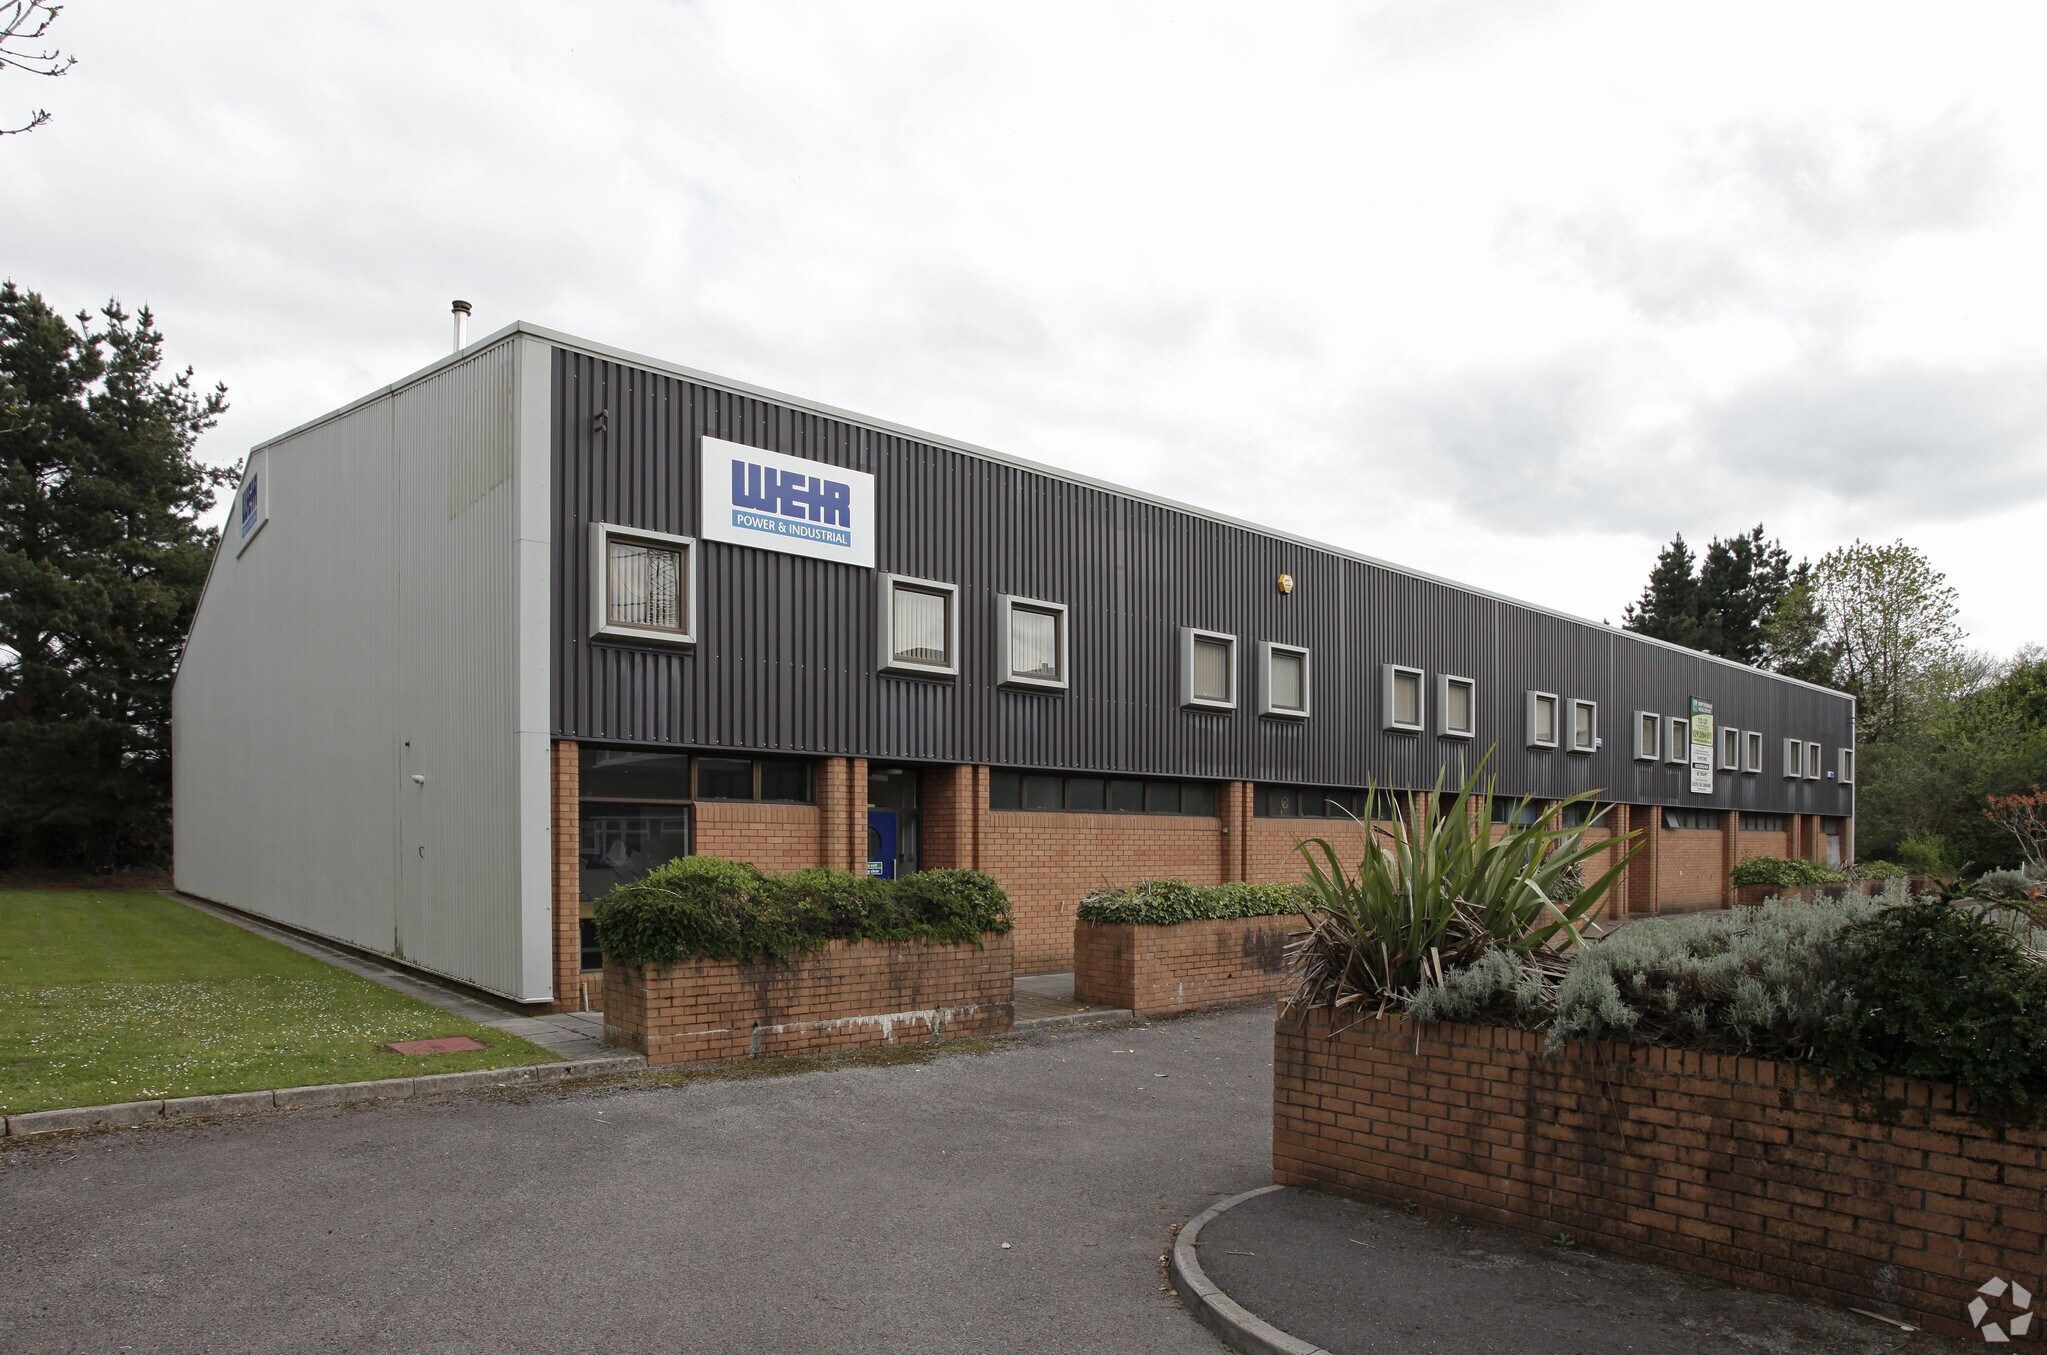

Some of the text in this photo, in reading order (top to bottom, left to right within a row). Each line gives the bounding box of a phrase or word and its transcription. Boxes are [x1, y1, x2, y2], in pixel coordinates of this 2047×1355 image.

[732, 459, 850, 528] WEIR
[737, 514, 847, 544] POWER & INDUSTRIAL
